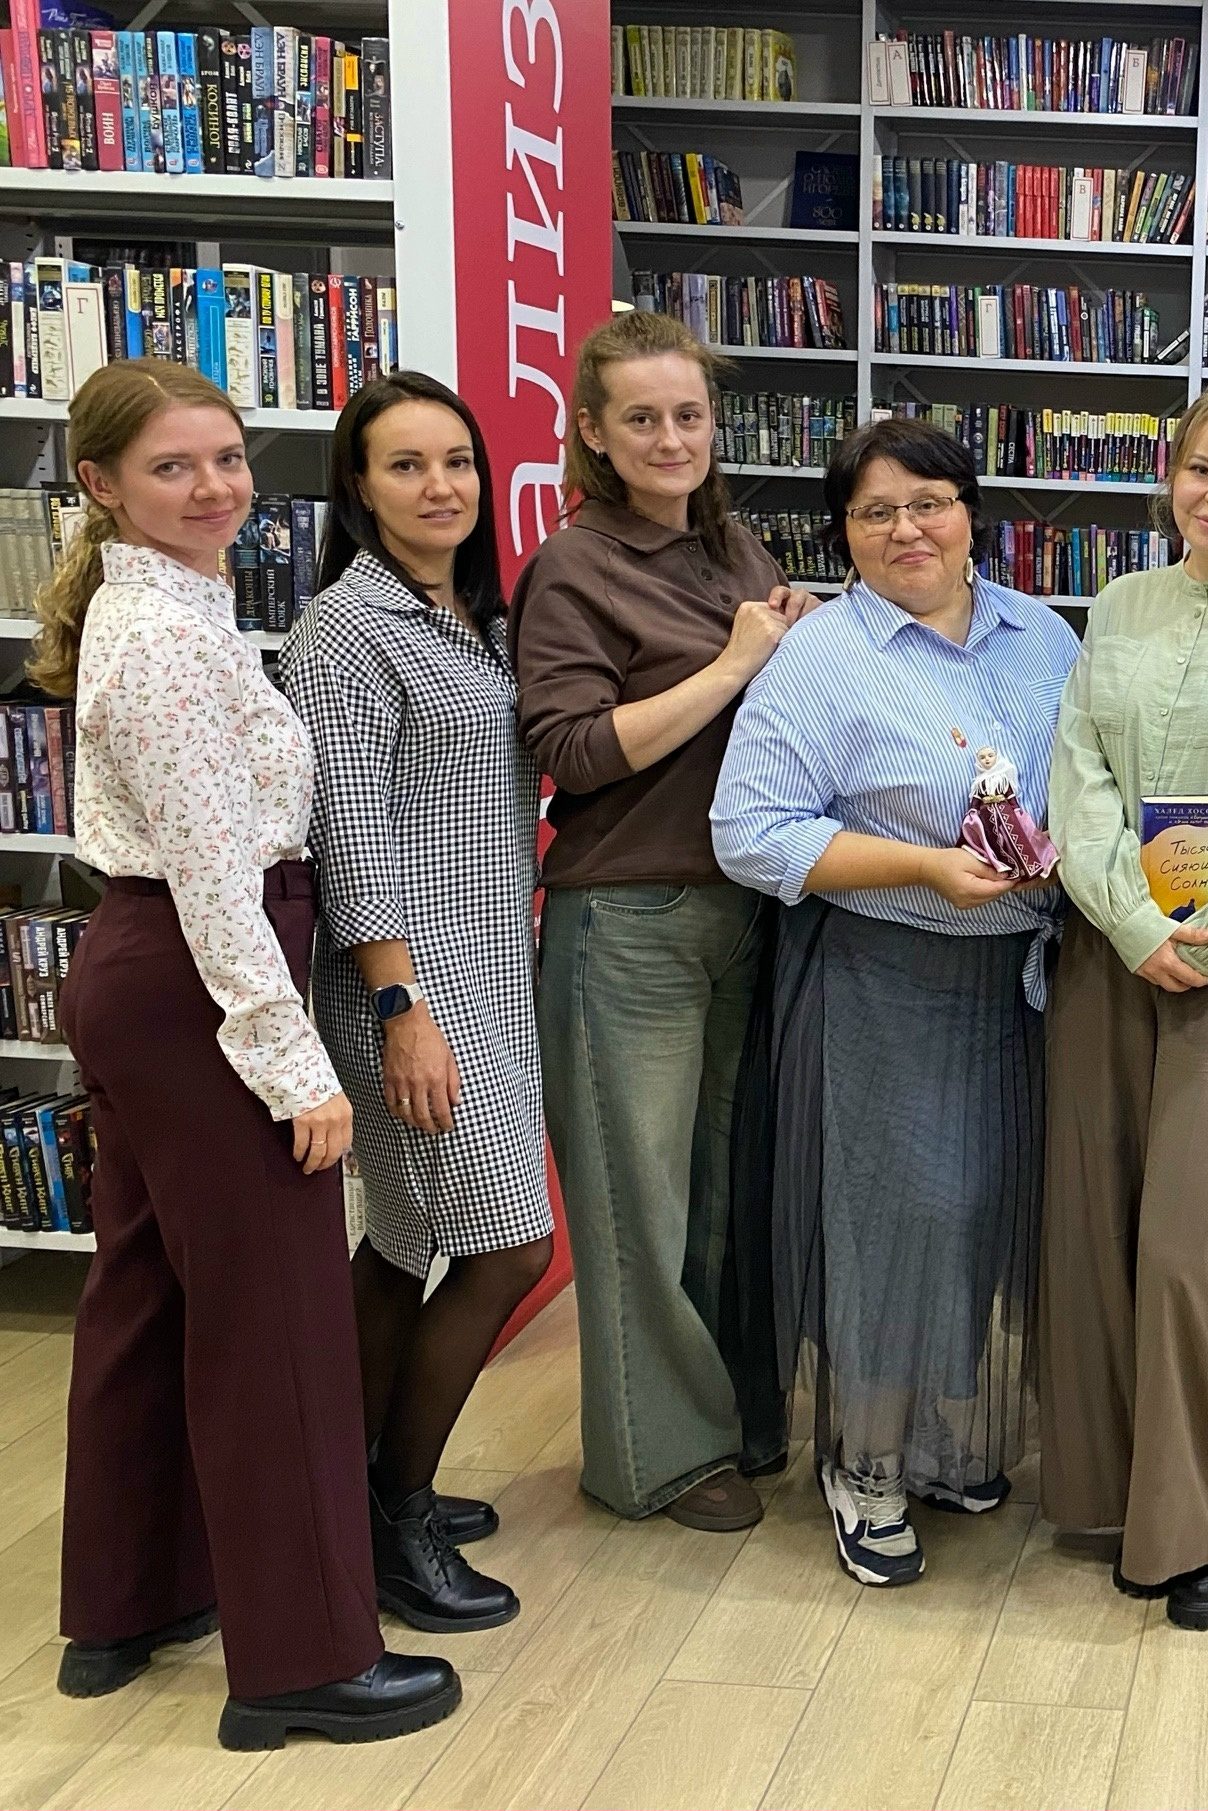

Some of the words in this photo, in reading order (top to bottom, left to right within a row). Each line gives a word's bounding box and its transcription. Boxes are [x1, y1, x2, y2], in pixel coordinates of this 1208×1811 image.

[254, 33, 264, 58] ДЭН
[276, 32, 286, 60] ДЭН
[893, 50, 903, 60] А
[1132, 57, 1140, 67] Б
[277, 61, 287, 99] БРАУН
[102, 112, 115, 145] ВОИН
[206, 83, 220, 148] КОСИНОГ
[1079, 184, 1086, 194] В
[77, 298, 89, 314] Г
[155, 308, 166, 319] МЕЧ
[350, 288, 359, 342] ГАРРИСОН
[364, 294, 375, 338] ПОЛОВИНКА
[986, 303, 992, 313] Г
[174, 302, 183, 366] АТАСТРОФА
[313, 323, 326, 360] ТУМАНА
[316, 363, 328, 385] ЗОНЕ
[244, 570, 255, 617] ДРАКОНЫ
[266, 568, 276, 627] ИМПЕРСКИЙ
[277, 601, 286, 628] ВОЯЖ
[1154, 807, 1185, 815] ХАЛЕД
[35, 927, 49, 957] АНДРЕЙ
[56, 928, 70, 958] АНДРЕЙ
[38, 958, 49, 978] КРУЗ
[9, 1146, 22, 1185] Стивен
[16, 1187, 29, 1215] Кинг
[28, 1146, 42, 1185] Стивен
[35, 1187, 48, 1216] Кинг
